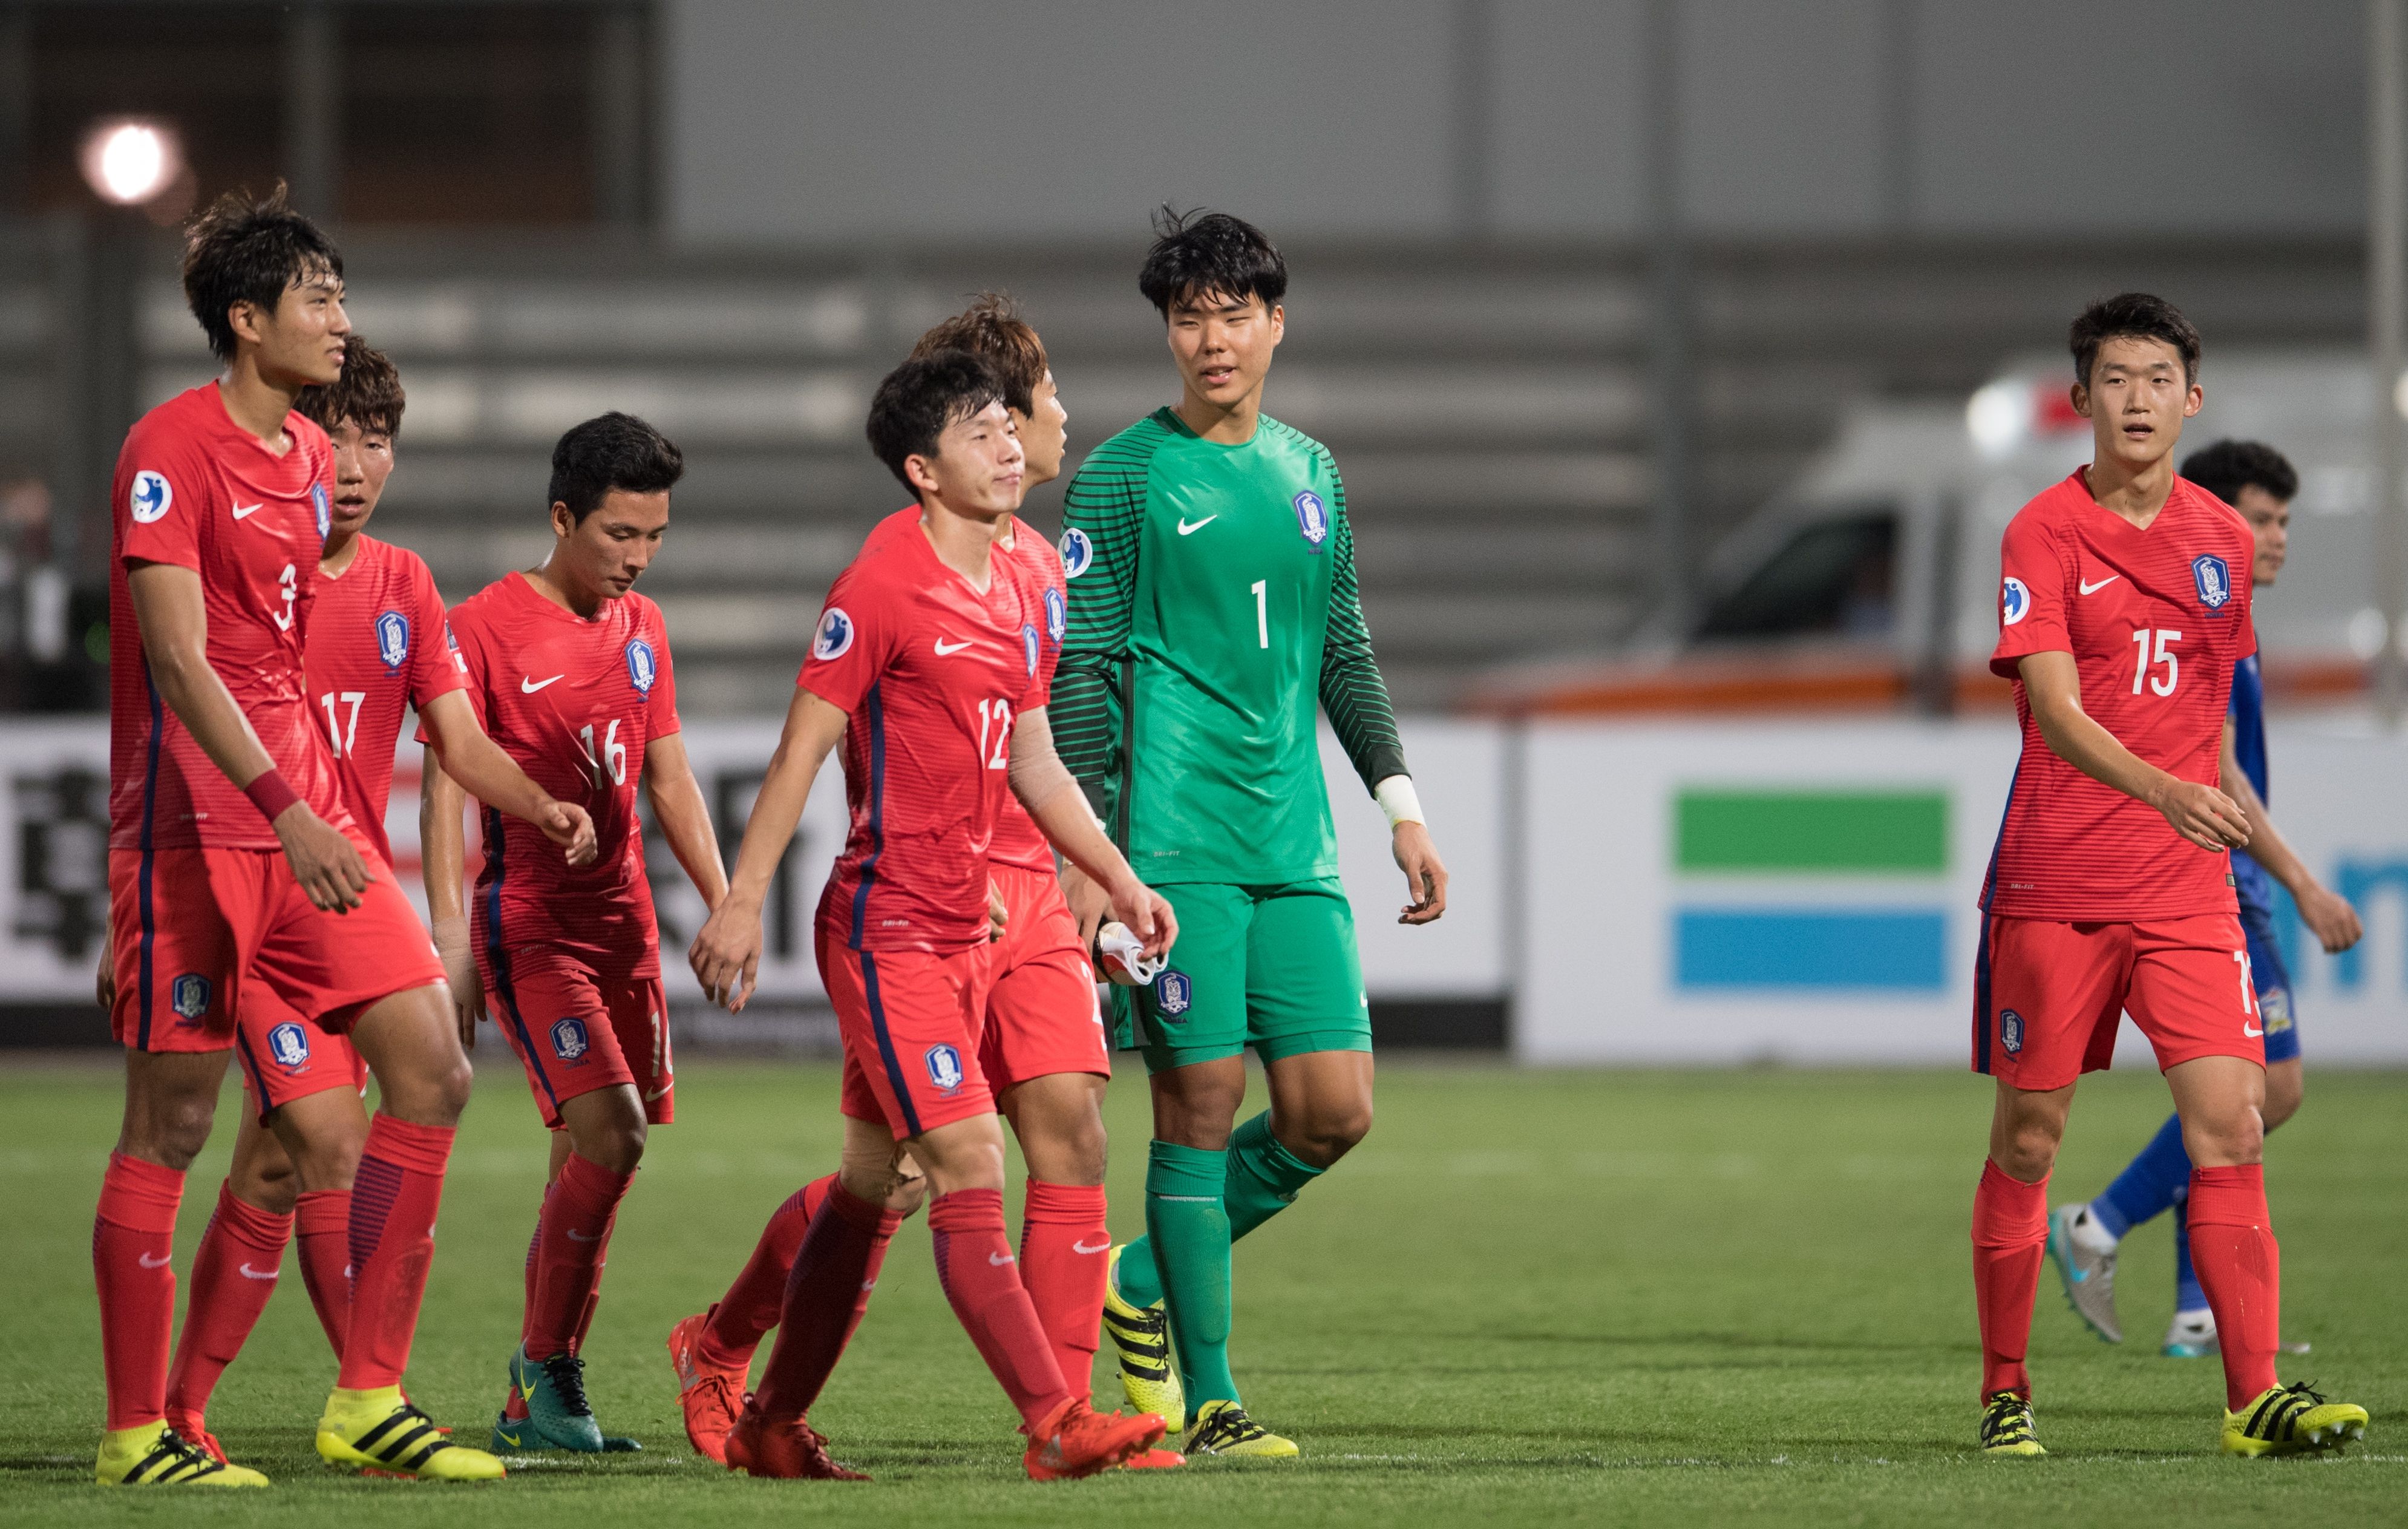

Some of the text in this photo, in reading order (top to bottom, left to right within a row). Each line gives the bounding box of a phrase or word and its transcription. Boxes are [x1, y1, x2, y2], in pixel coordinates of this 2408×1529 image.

[273, 563, 297, 632] 3
[1251, 579, 1269, 649] 1
[2132, 629, 2182, 697] 15
[321, 692, 367, 760] 17
[580, 719, 626, 790] 16
[978, 698, 1011, 770] 12
[2233, 950, 2262, 1021] 1
